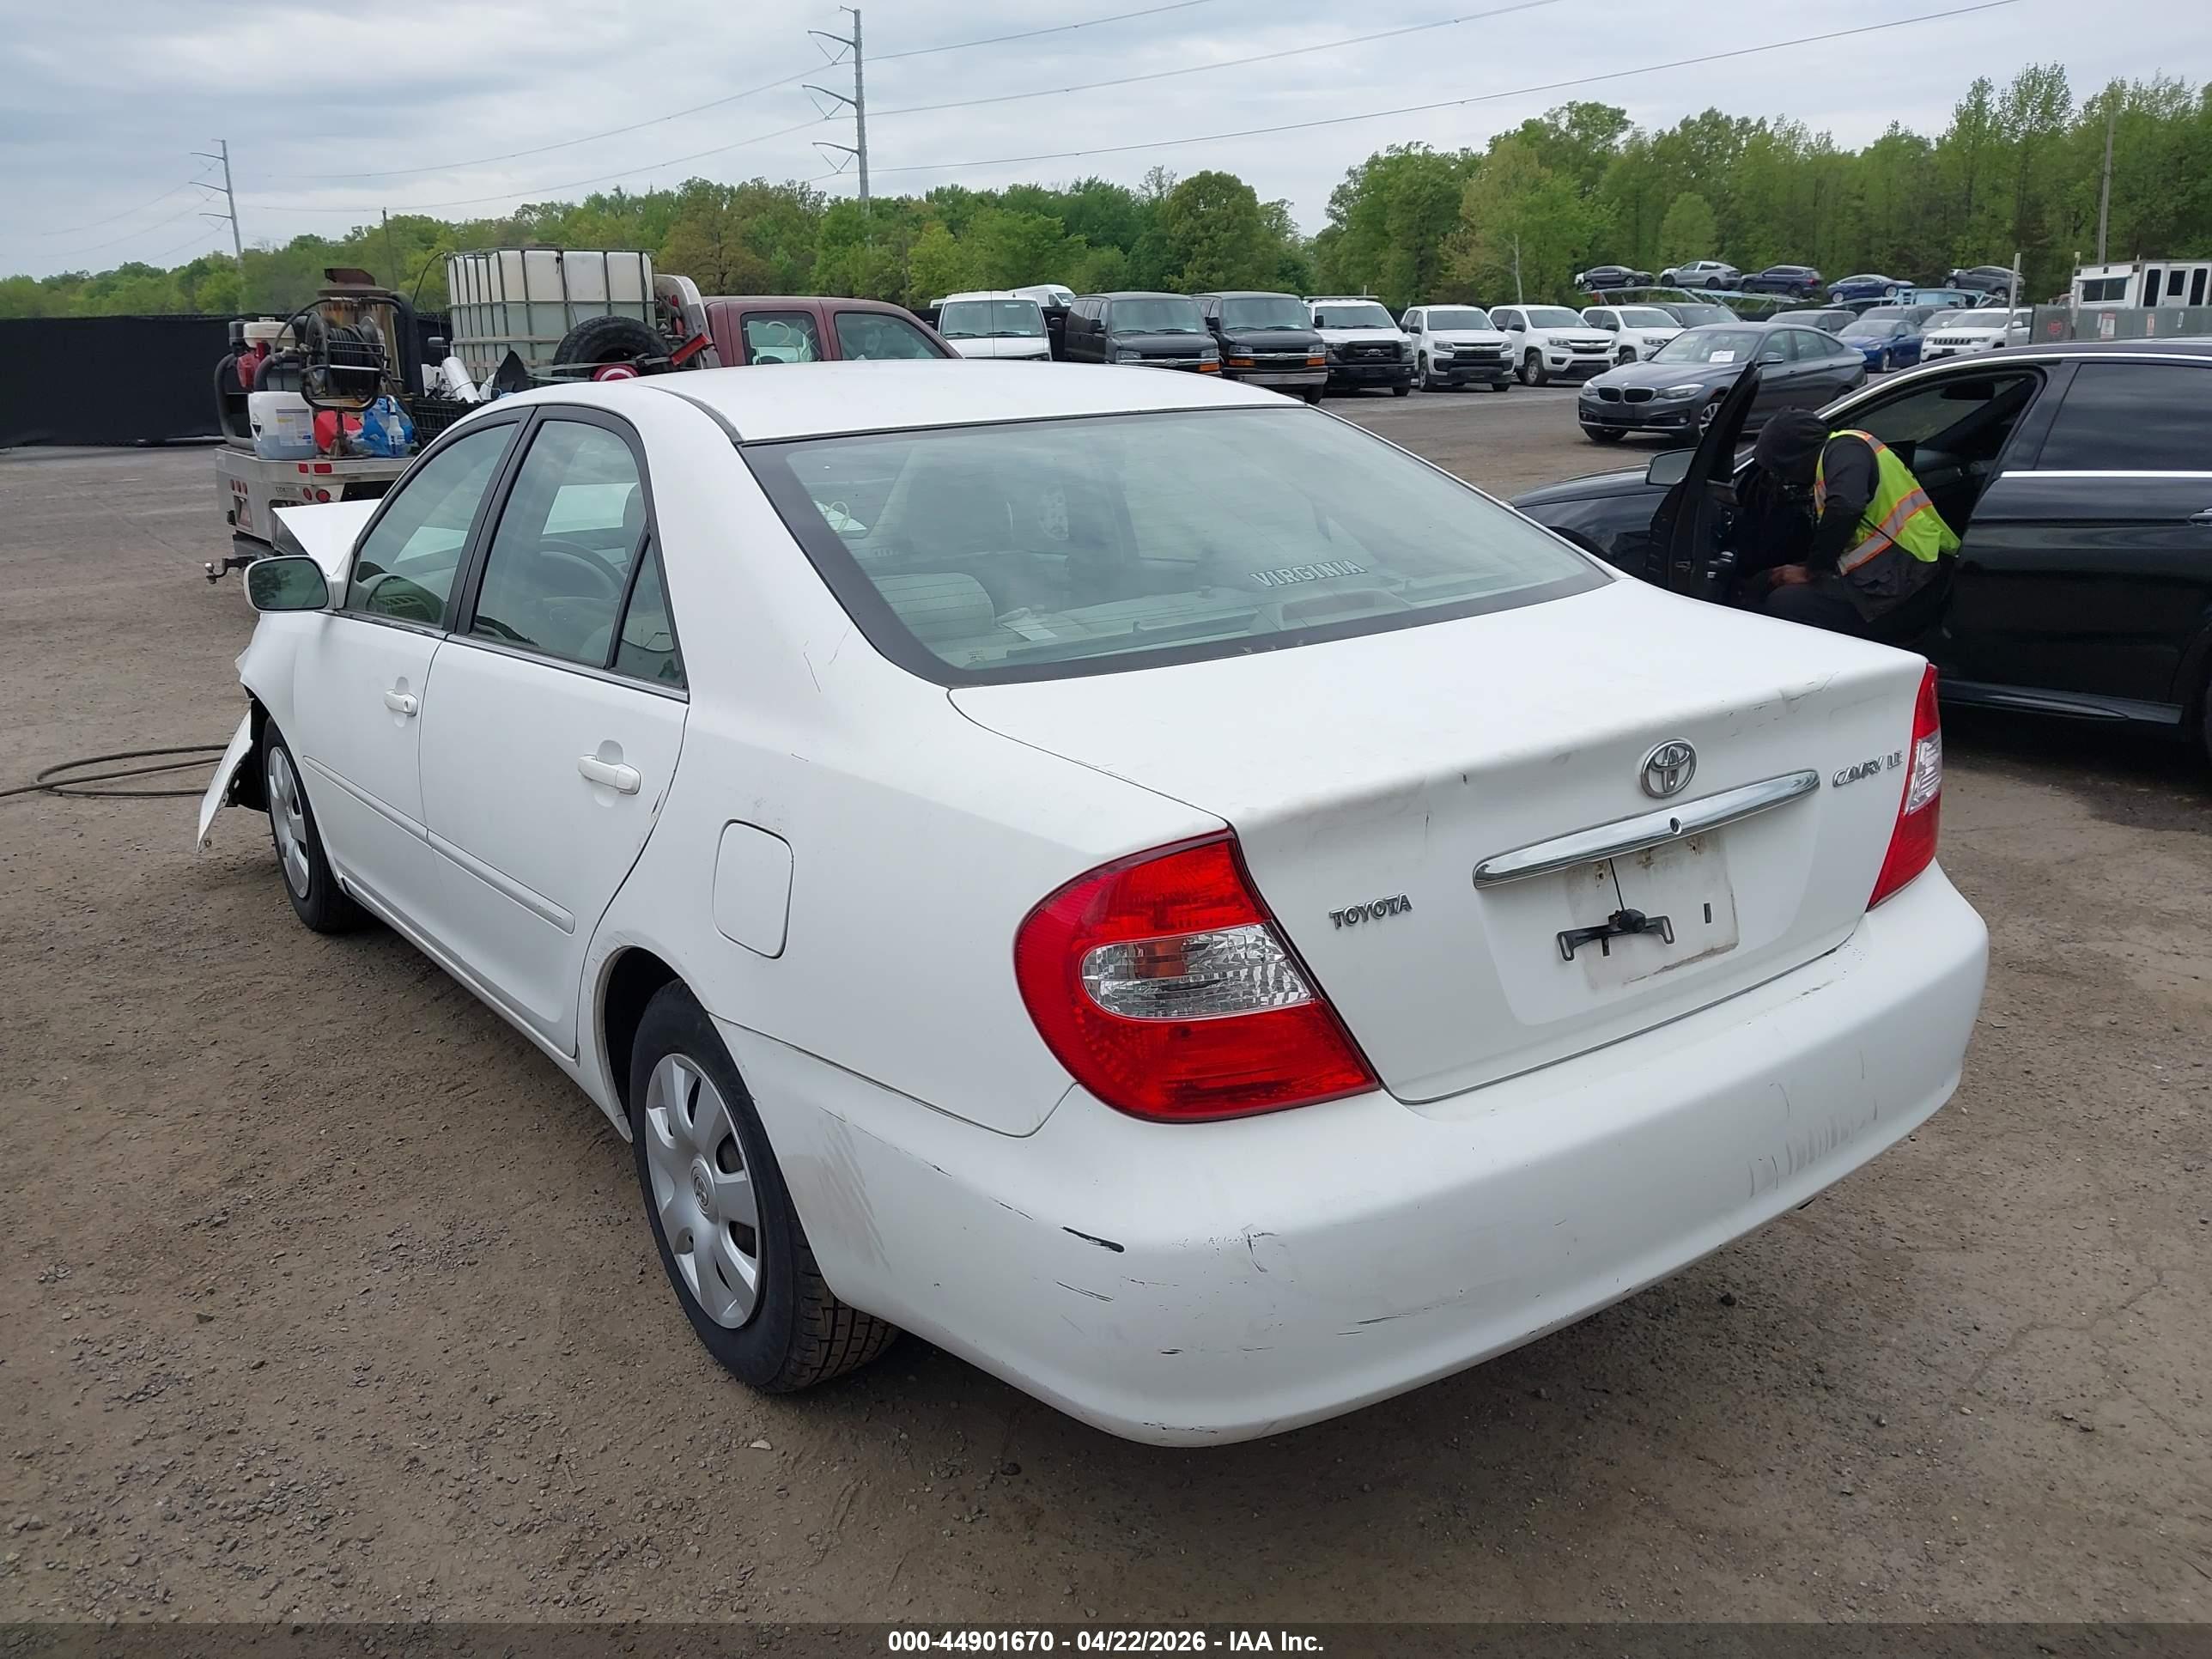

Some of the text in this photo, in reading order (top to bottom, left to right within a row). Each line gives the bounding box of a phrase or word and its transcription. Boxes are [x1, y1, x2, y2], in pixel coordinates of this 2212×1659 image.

[1249, 558, 1368, 587] VIRGINIA
[1887, 750, 1903, 769] LE
[1329, 893, 1413, 929] TOYOTA
